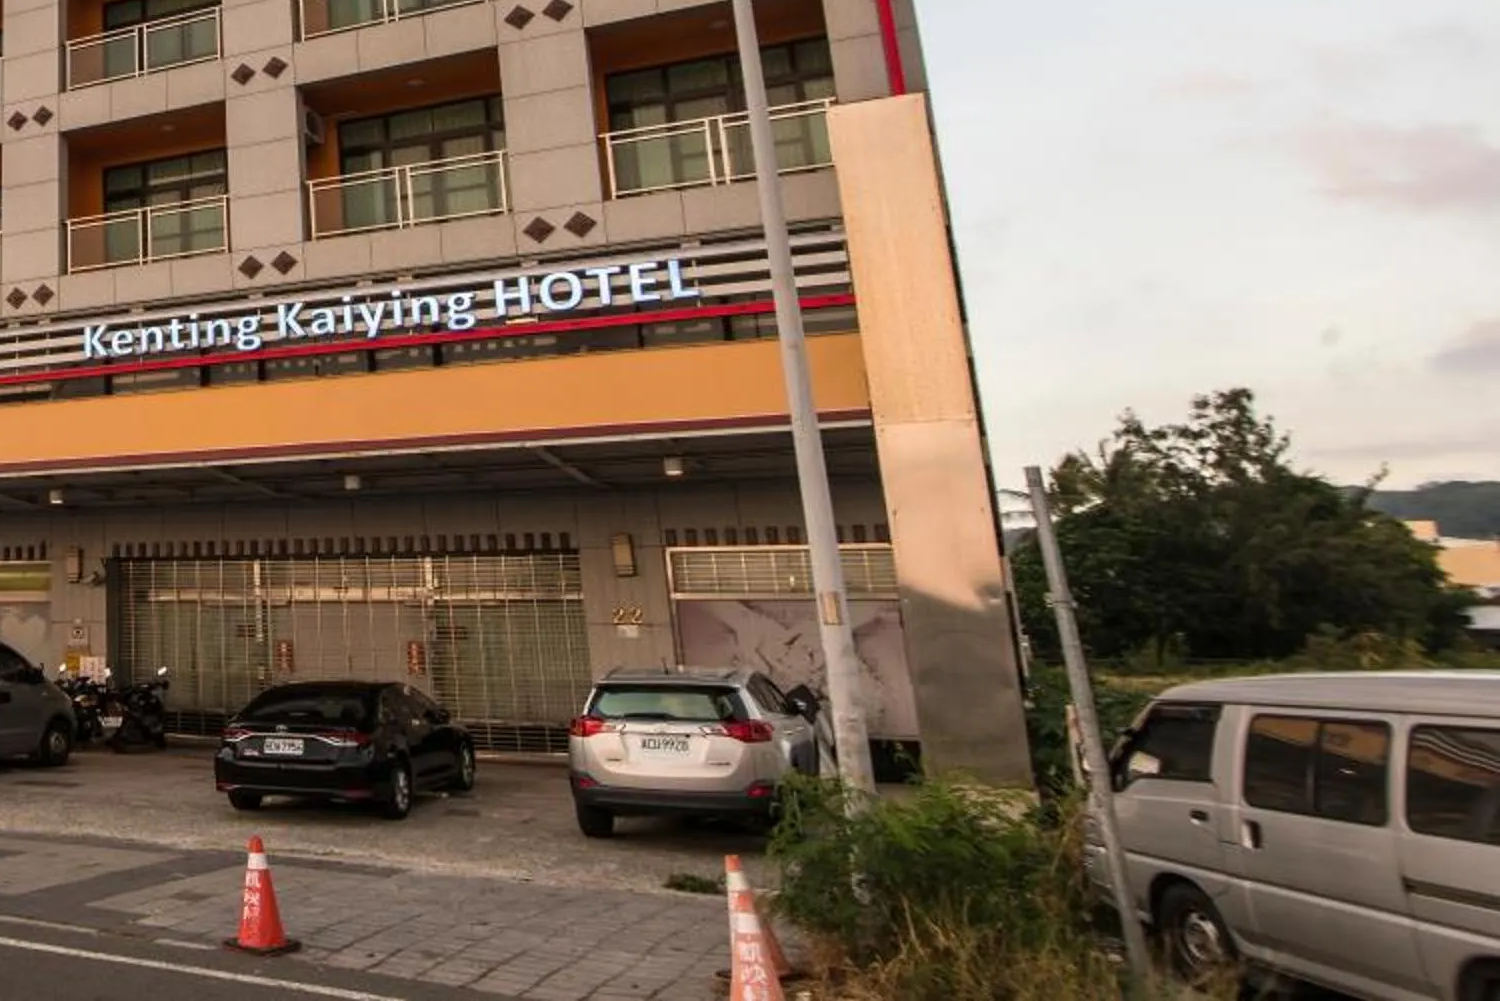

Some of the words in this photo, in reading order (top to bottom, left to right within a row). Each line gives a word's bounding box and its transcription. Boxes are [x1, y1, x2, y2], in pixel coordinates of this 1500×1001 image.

[83, 312, 262, 359] Kenting
[277, 290, 477, 339] Kaiying
[493, 259, 700, 316] HOTEL
